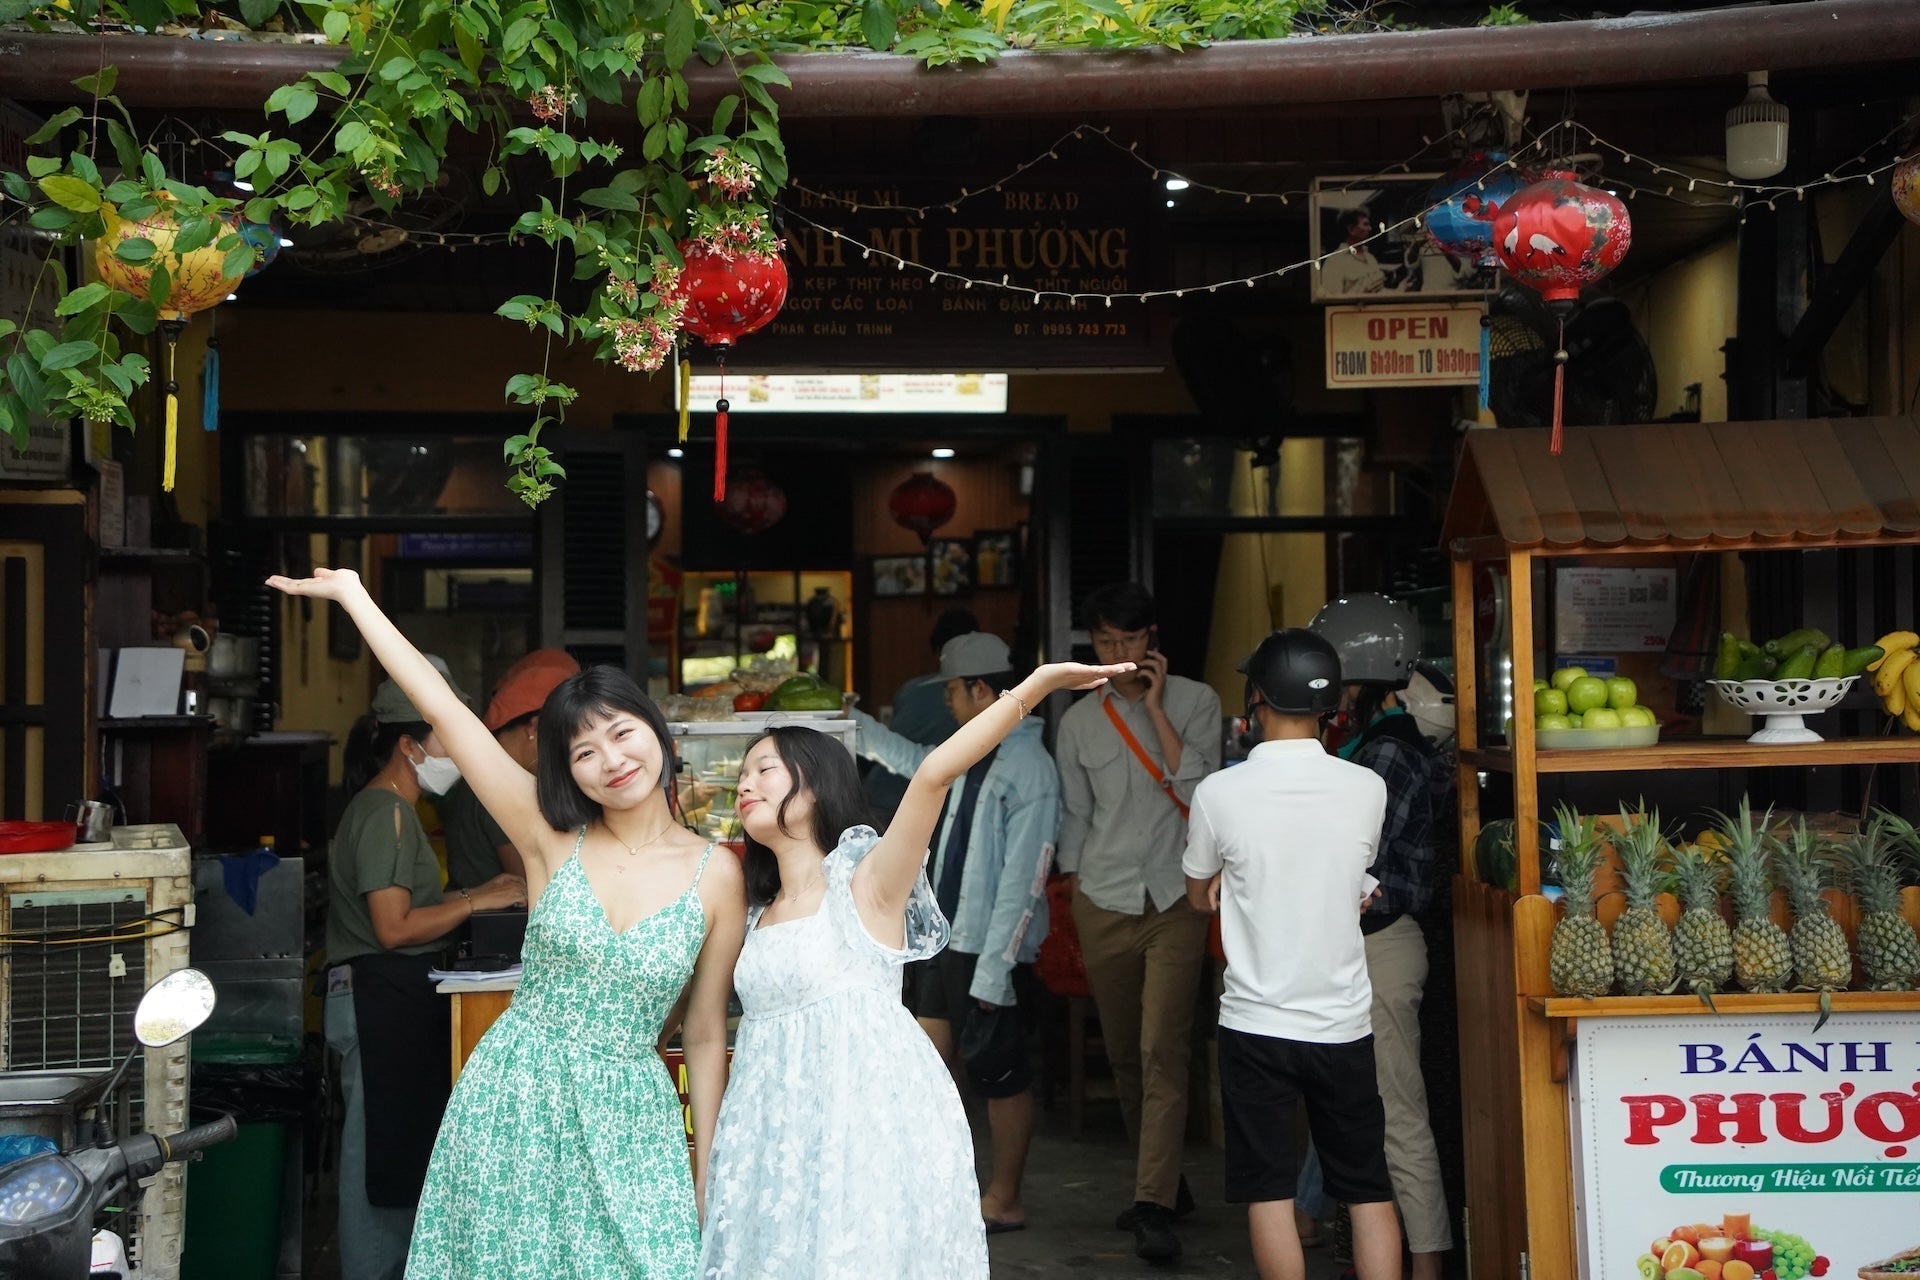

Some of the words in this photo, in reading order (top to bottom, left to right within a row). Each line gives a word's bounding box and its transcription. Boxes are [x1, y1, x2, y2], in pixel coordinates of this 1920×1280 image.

[1004, 191, 1080, 210] BREAD
[783, 227, 846, 267] NH
[868, 216, 922, 268] MÌ
[945, 220, 1129, 275] PHƯỢNG
[848, 277, 882, 294] THỊT
[891, 277, 923, 291] HEO
[831, 294, 865, 311] CÁC
[875, 296, 913, 315] LOẠI
[942, 295, 987, 312] BÁNH
[1077, 323, 1101, 336] 743
[1104, 323, 1127, 336] 773
[1367, 316, 1449, 341] OPEN
[1335, 351, 1367, 376] FROM
[1370, 350, 1414, 375] 6h30am
[1418, 348, 1433, 374] TO
[1437, 348, 1481, 376] 9h30pm
[1679, 1032, 1893, 1074] BÁNH
[1673, 1169, 1766, 1192] Thương
[1771, 1168, 1826, 1190] Hiệu
[1832, 1164, 1876, 1187] Nổi
[1880, 1164, 1920, 1187] Tiế
